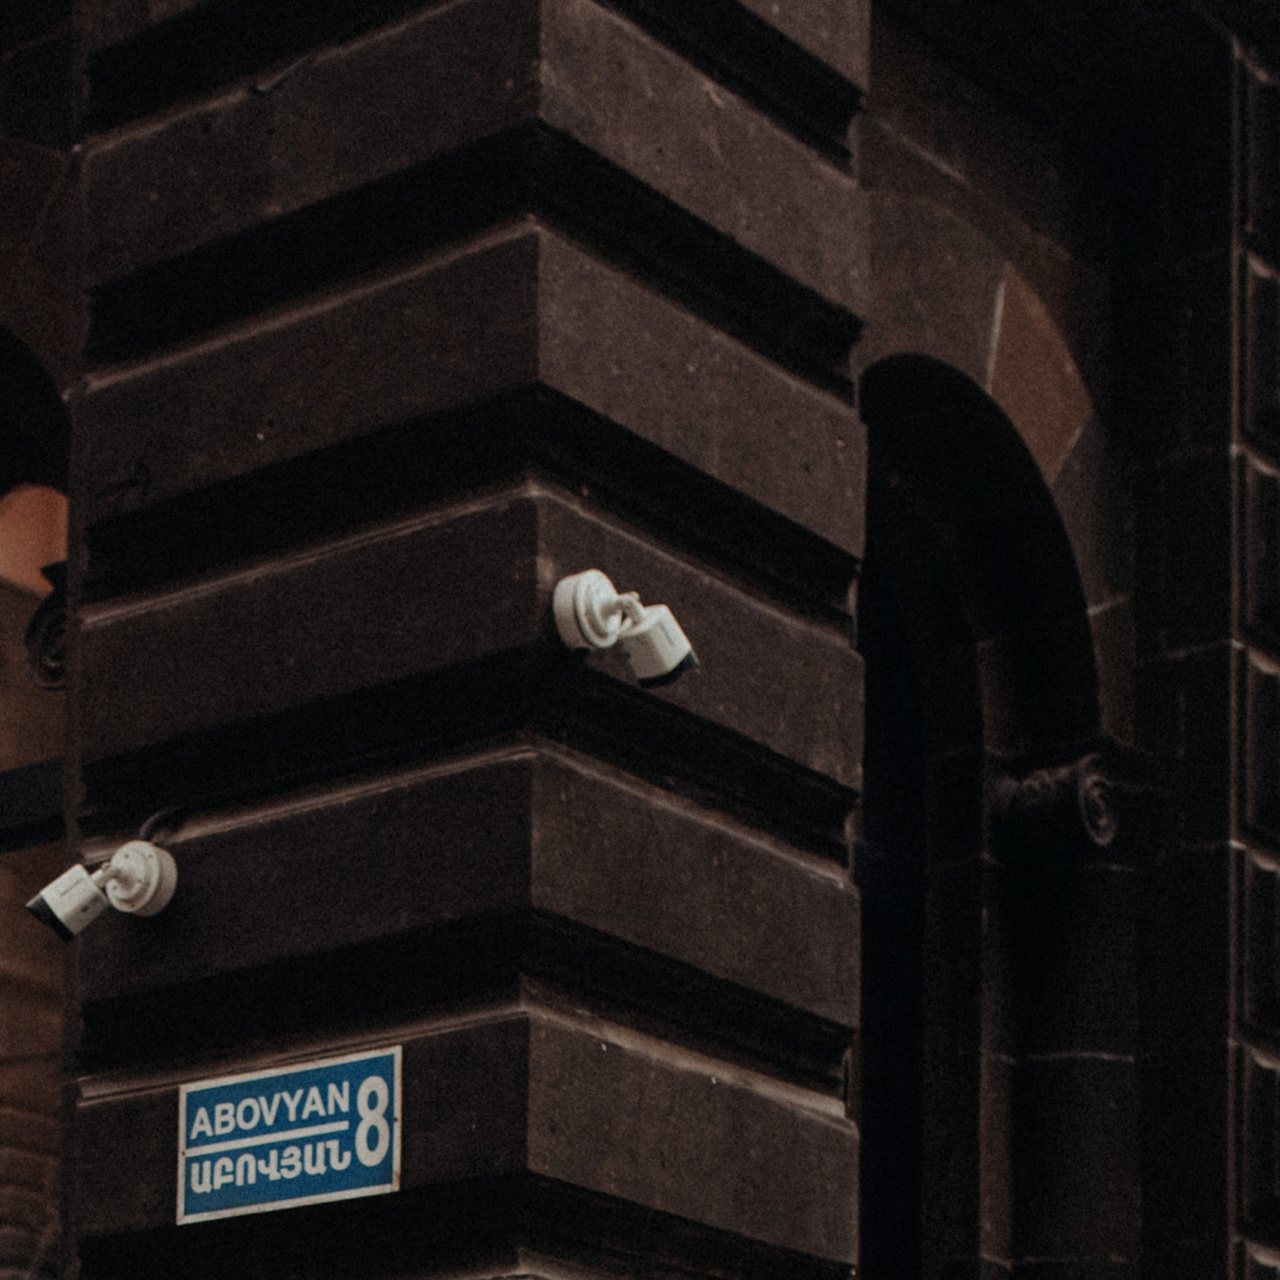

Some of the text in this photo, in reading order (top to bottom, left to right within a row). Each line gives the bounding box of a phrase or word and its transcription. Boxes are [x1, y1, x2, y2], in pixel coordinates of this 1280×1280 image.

[190, 1080, 350, 1139] ABOVYAN
[355, 1075, 390, 1167] 8
[190, 1139, 351, 1194] ԱԲՈՎՅԱՆ
